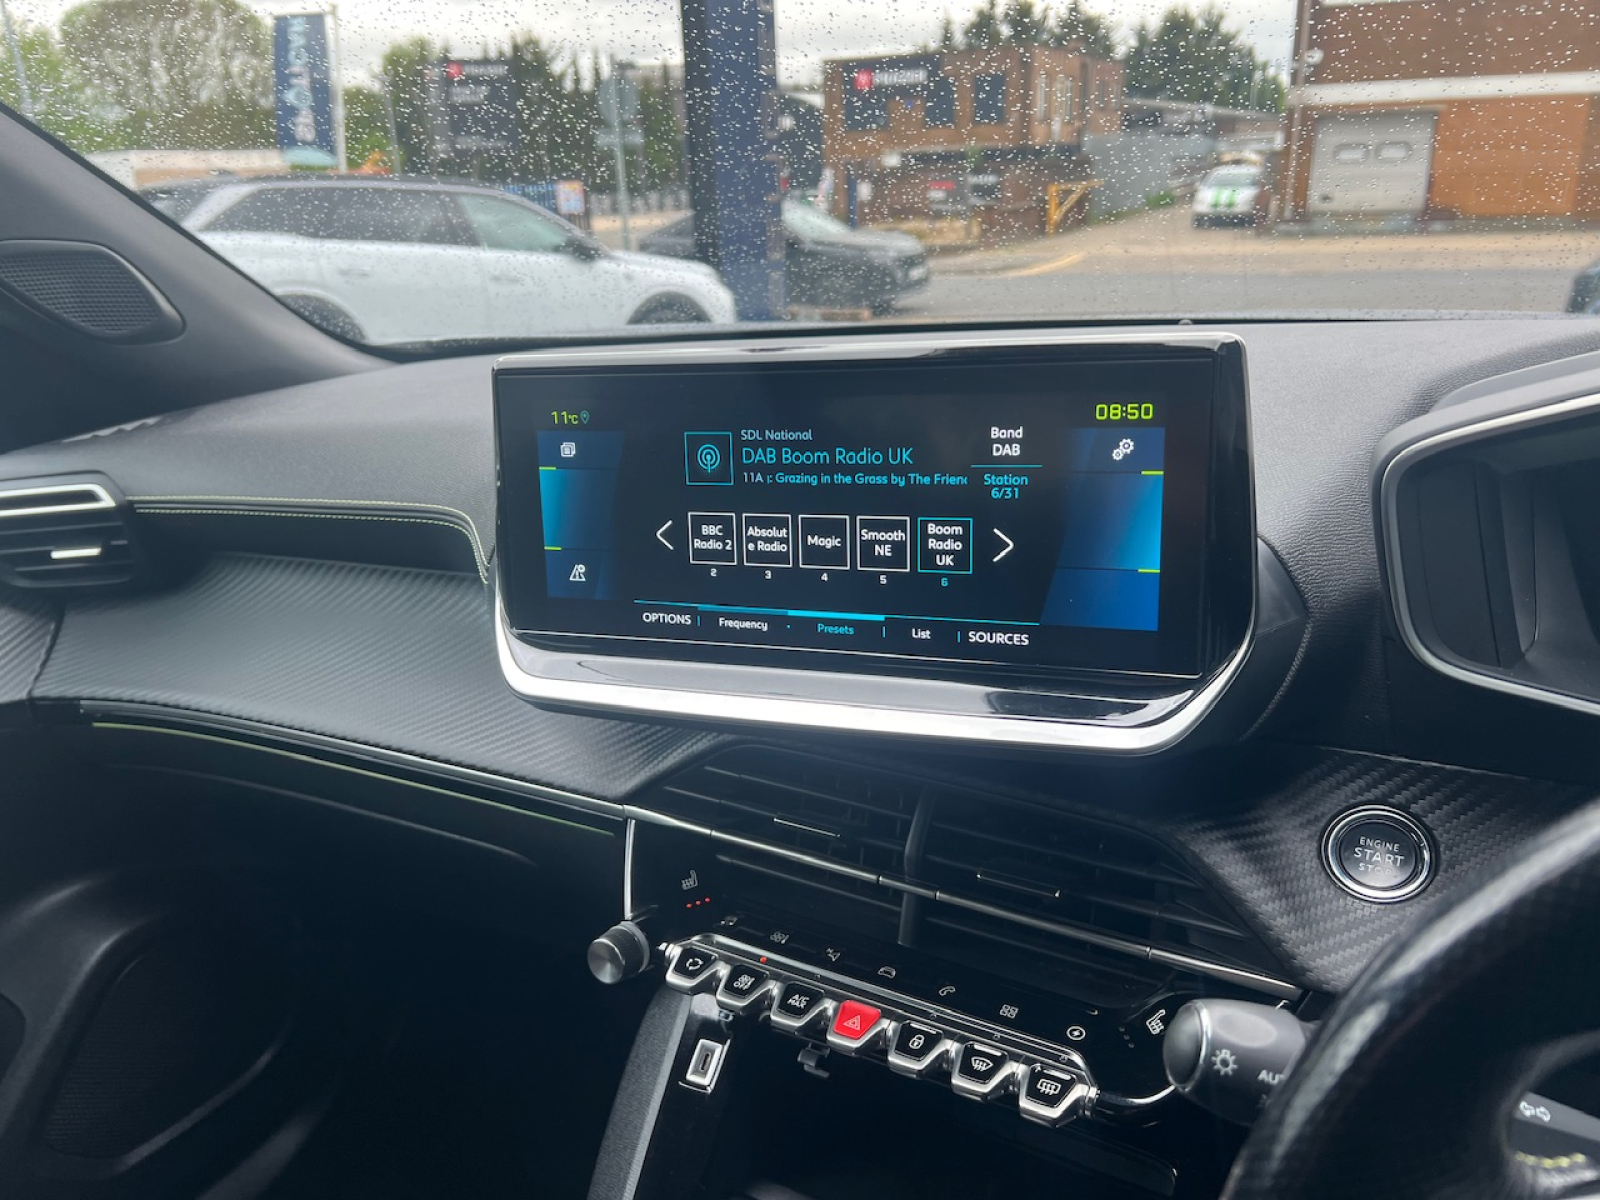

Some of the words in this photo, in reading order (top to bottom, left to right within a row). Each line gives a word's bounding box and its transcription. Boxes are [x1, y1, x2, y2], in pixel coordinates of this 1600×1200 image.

[1096, 404, 1153, 420] 08:50
[741, 430, 762, 440] SDL
[765, 429, 812, 440] National
[991, 426, 1022, 438] Band
[993, 444, 1020, 456] DAB
[743, 448, 776, 463] DAB
[782, 448, 829, 464] Boom
[836, 448, 883, 464] Radio
[889, 448, 912, 464] UK
[744, 472, 763, 482] 11A
[776, 472, 817, 485] Grazing
[821, 474, 830, 483] in
[834, 473, 852, 484] the
[855, 473, 888, 484] Grass
[891, 474, 905, 486] by
[908, 474, 930, 484] The
[984, 474, 1028, 485] Station
[991, 488, 1018, 498] 6/31
[702, 525, 723, 535] BBC
[747, 526, 787, 537] Absolut
[928, 523, 962, 535] Boom
[861, 529, 905, 541] Smooth
[694, 539, 723, 549] Radio
[725, 540, 732, 550] 2
[758, 541, 787, 551] Radio
[808, 535, 841, 548] Magic
[929, 539, 962, 550] Radio
[875, 545, 891, 556] NE
[936, 555, 954, 565] UK
[765, 570, 771, 579] 3
[821, 573, 827, 581] 4
[880, 575, 886, 584] 5
[941, 578, 948, 586] 6
[643, 613, 691, 624] OPTIONS
[719, 618, 767, 631] Frequency
[818, 624, 854, 634] Presets
[912, 629, 930, 639] List
[969, 631, 1029, 645] SOURCES
[1360, 837, 1399, 851] ENGINE
[1354, 847, 1404, 866] START
[1359, 863, 1392, 875] STOP
